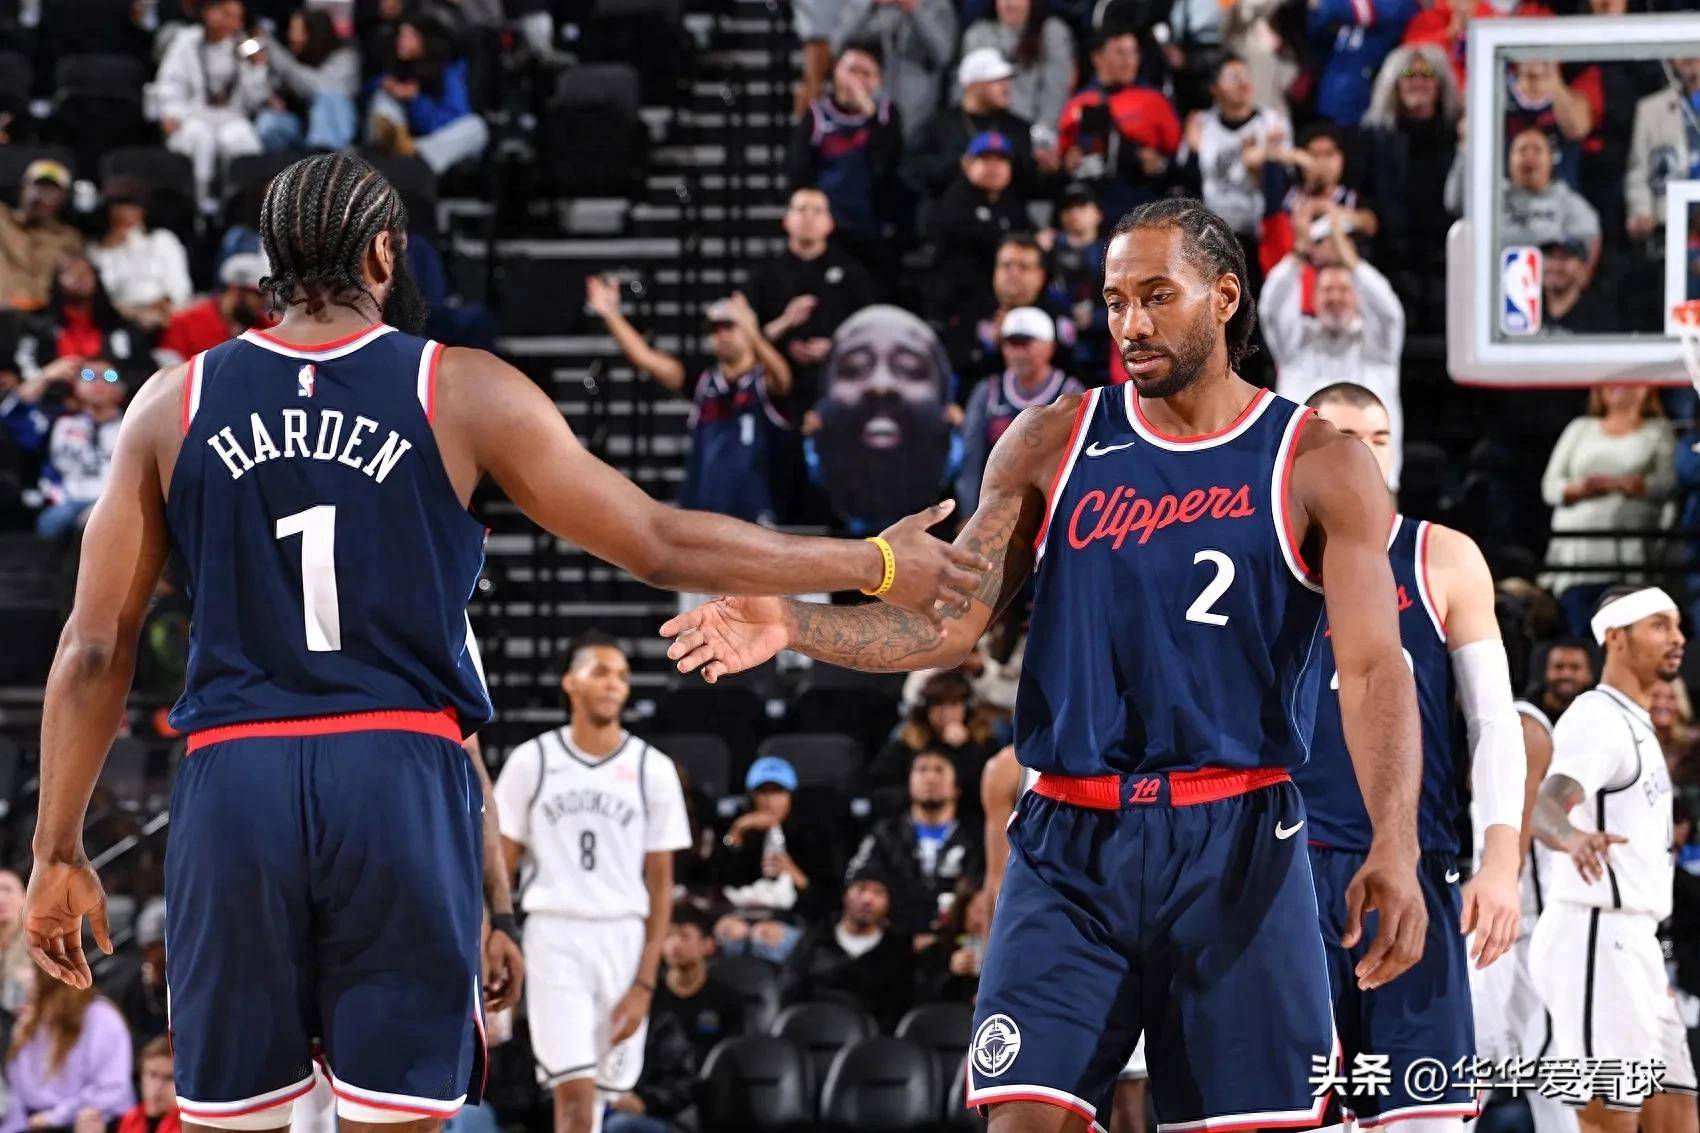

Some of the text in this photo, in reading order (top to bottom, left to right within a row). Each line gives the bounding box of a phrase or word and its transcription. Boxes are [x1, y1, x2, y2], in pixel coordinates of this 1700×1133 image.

[207, 408, 412, 484] HARDEN
[1068, 483, 1255, 550] Clippers
[275, 504, 342, 652] 1
[1185, 549, 1236, 626] 2
[541, 789, 636, 828] BROOKLYN
[1129, 777, 1161, 803] LA
[580, 829, 596, 871] 8
